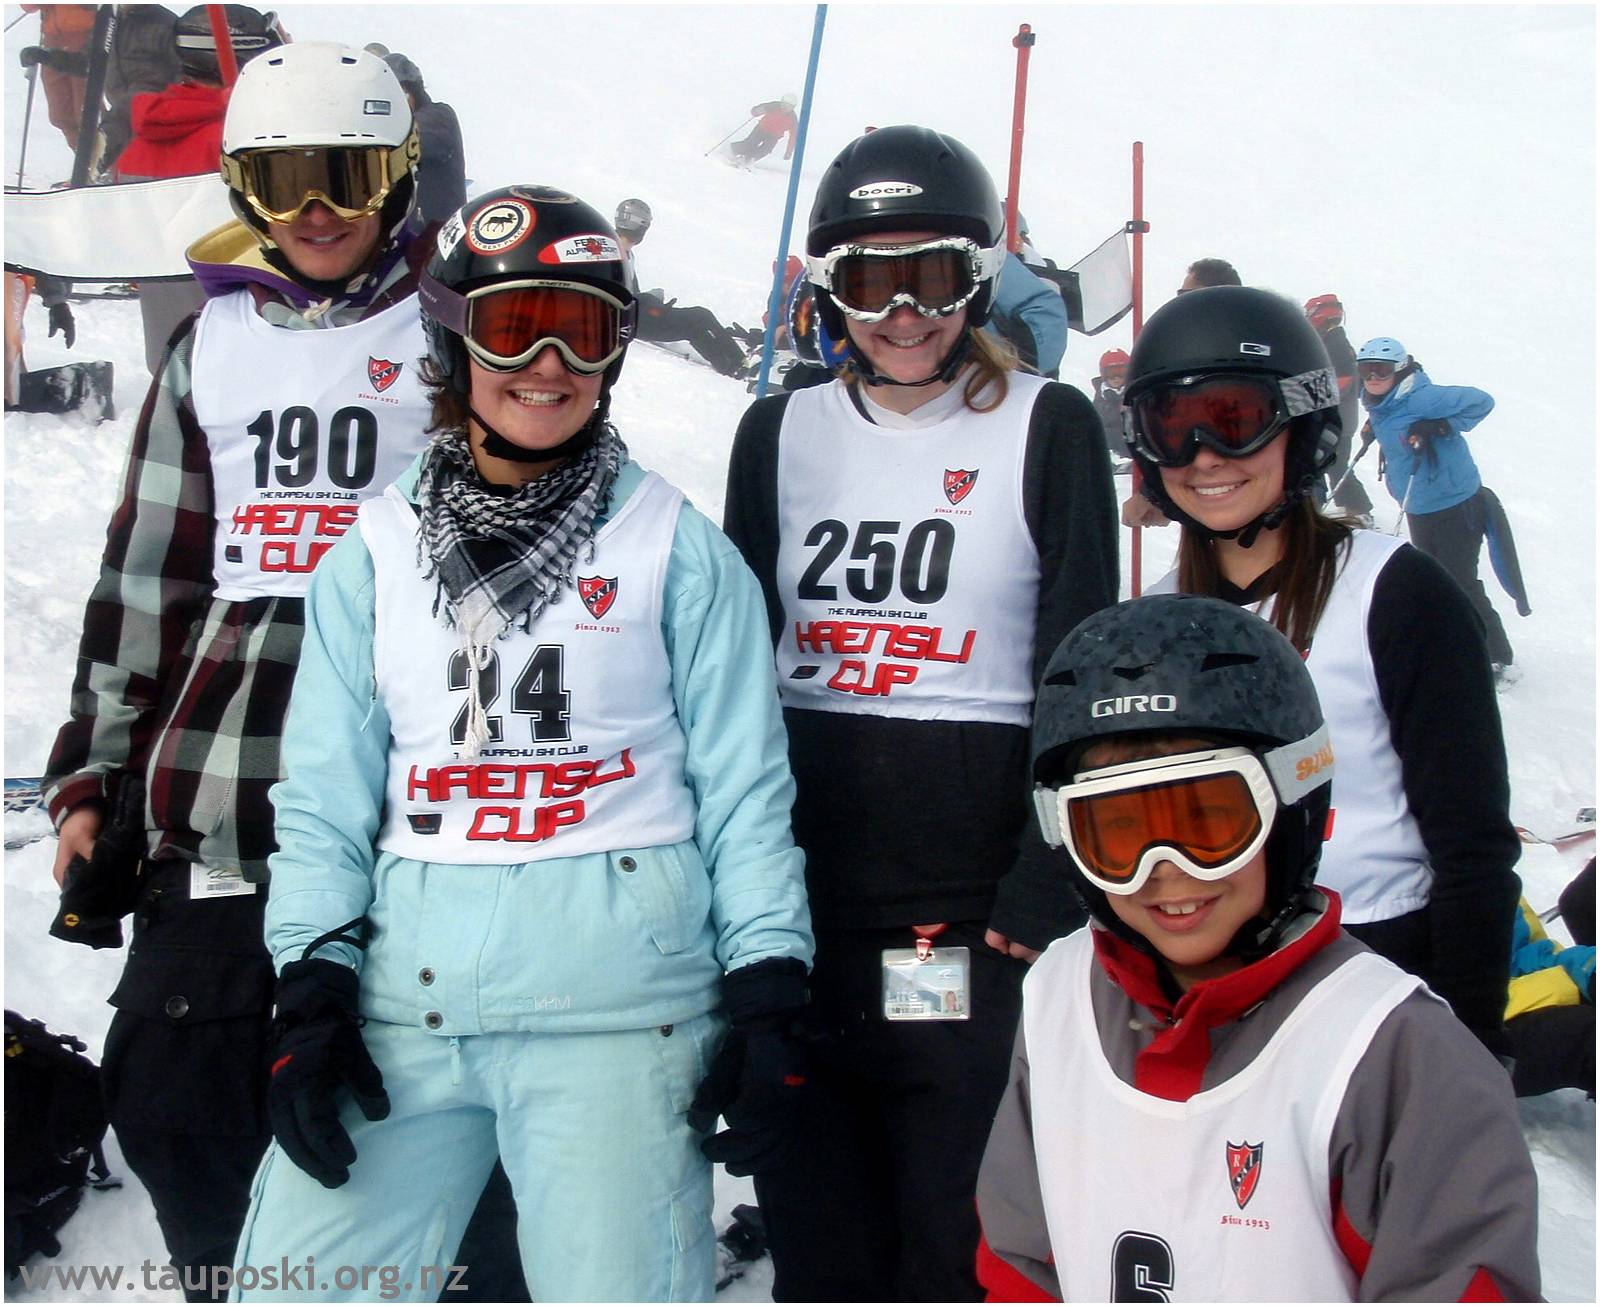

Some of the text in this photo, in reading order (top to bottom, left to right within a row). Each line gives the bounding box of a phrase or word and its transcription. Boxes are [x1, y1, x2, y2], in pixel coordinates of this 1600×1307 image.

[104, 17, 117, 53] ATOMIC
[246, 405, 378, 490] 190
[275, 491, 315, 500] RUAPEHU
[332, 492, 359, 500] CLUB
[231, 504, 360, 536] HAENS
[798, 518, 956, 605] 250
[846, 608, 887, 618] RUAPEHU
[903, 611, 928, 620] CLUB
[795, 620, 978, 664] HAENSLI
[447, 643, 572, 745] 24
[826, 659, 920, 697] CUP
[1091, 694, 1177, 718] GIRO
[557, 745, 589, 756] CLUB
[407, 747, 636, 802] HAENSLI
[465, 799, 586, 843] CUP
